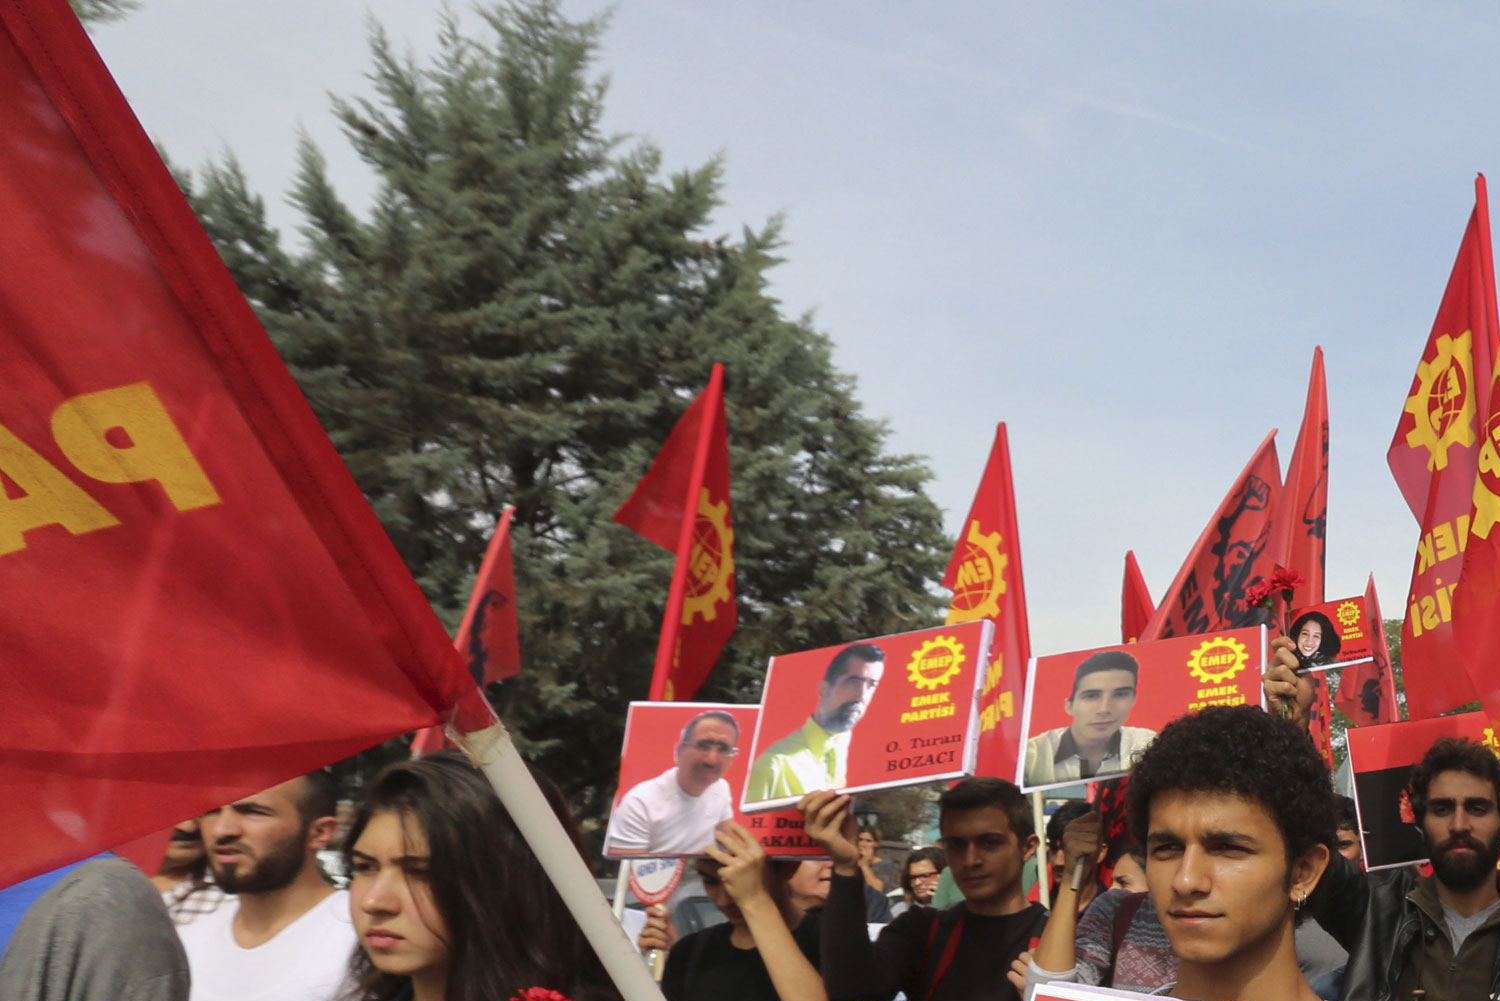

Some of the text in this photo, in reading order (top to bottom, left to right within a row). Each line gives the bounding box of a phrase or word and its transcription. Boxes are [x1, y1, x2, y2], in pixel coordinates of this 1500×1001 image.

[918, 655, 954, 671] EMEP
[1200, 653, 1236, 668] EMEP
[911, 691, 951, 708] EMEK
[1196, 684, 1239, 699] EMEK
[900, 702, 956, 724] PARTİSİ
[909, 733, 962, 750] Turan
[886, 750, 957, 773] BOZACI
